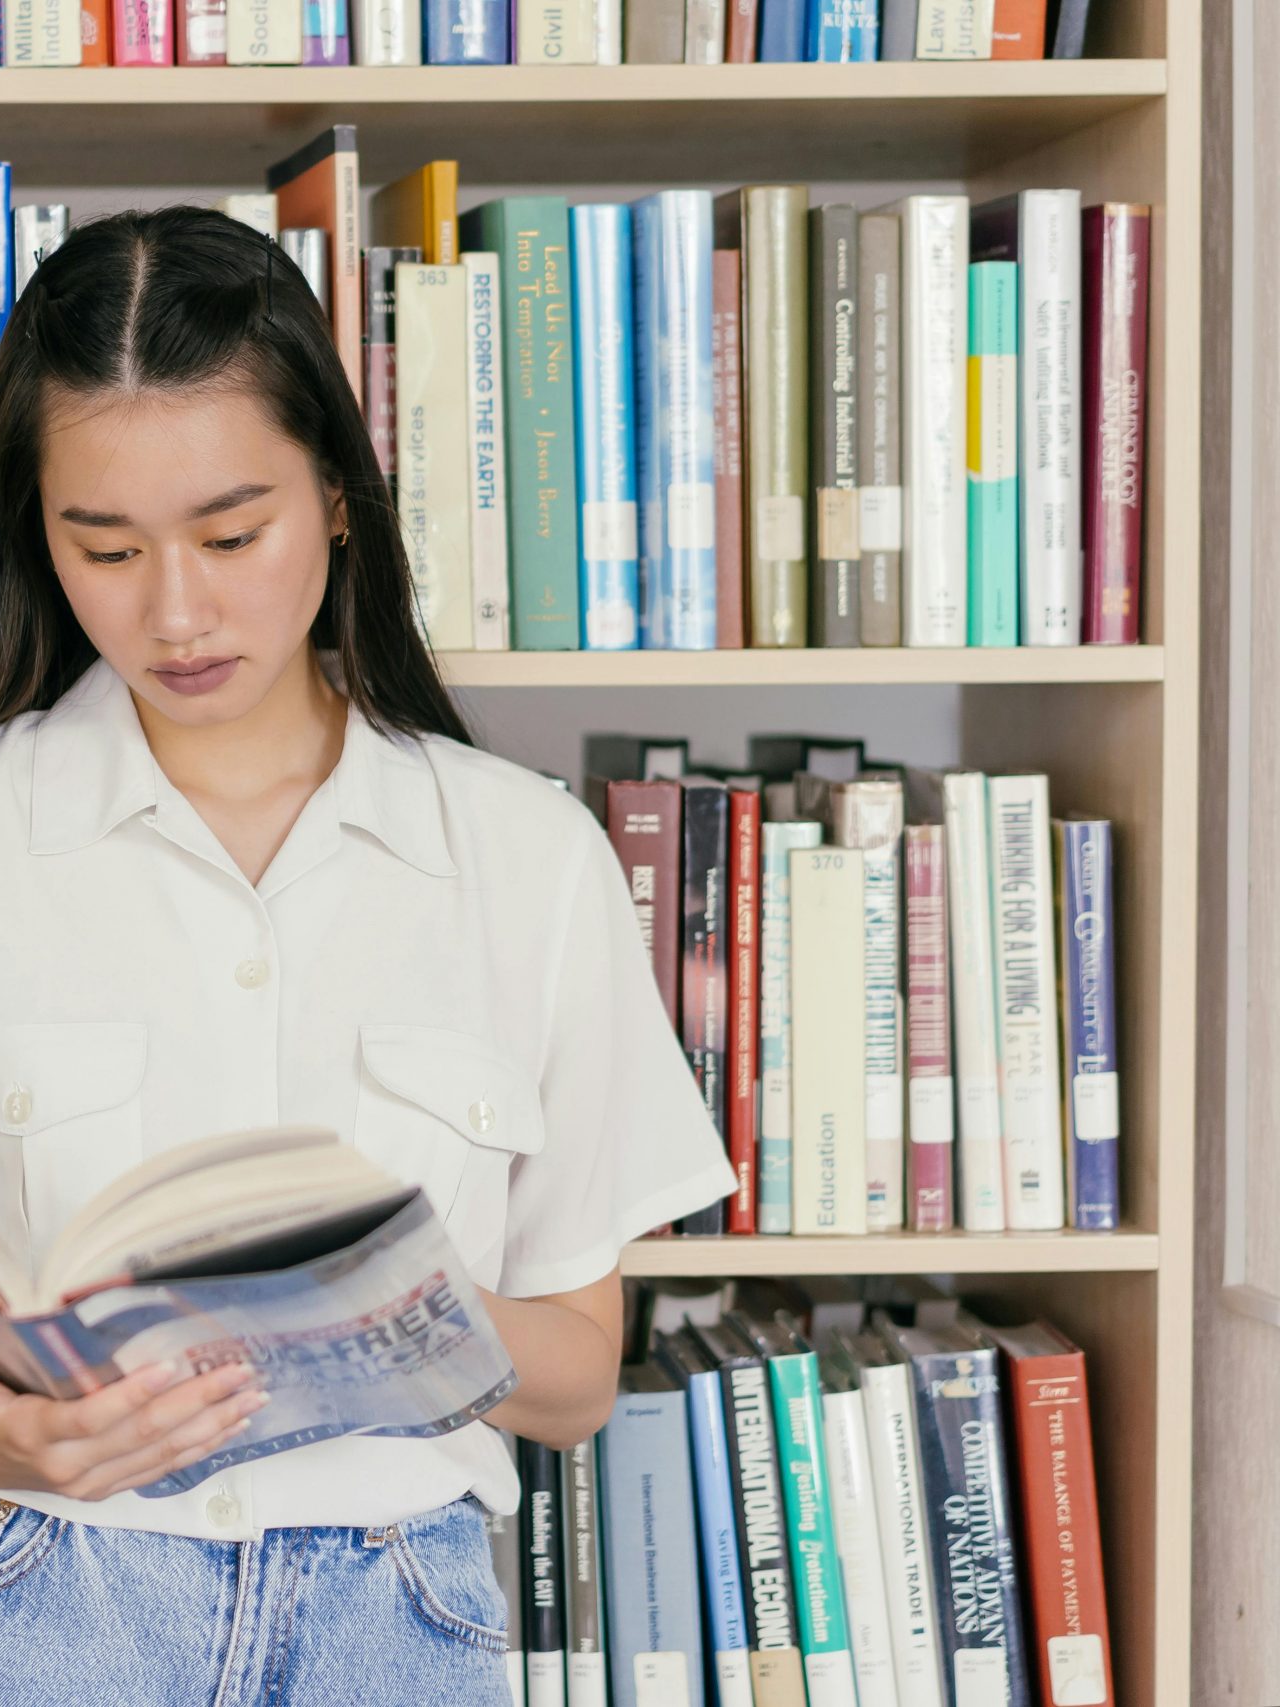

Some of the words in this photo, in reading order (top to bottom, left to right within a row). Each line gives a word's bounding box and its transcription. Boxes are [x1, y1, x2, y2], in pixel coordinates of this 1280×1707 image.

[543, 9, 562, 58] Civil
[926, 8, 943, 53] Law
[417, 269, 447, 285] 363
[517, 230, 540, 273] Into
[544, 245, 565, 294] Lead
[474, 273, 493, 393] RESTORING
[514, 278, 542, 399] Temptation
[546, 303, 566, 333] Us
[547, 340, 569, 383] Not
[833, 298, 854, 393] Controlling
[476, 398, 494, 434] THE
[835, 396, 854, 473] Industrial
[1119, 370, 1138, 508] CRIMINOLOGY
[410, 405, 426, 500] services
[477, 441, 495, 510] EARTH
[534, 428, 558, 481] Jason
[535, 488, 559, 538] Berry
[412, 507, 429, 574] social
[812, 856, 843, 870] 370
[999, 799, 1036, 893] THINKING
[1002, 899, 1037, 934] FOR
[1004, 939, 1037, 952] A
[1005, 958, 1040, 1017] LIVING
[816, 1113, 836, 1226] Education
[1048, 1409, 1066, 1445] THE
[730, 1367, 784, 1566] INTERNATIONAL
[960, 1420, 999, 1559] COMPETITIVE
[1051, 1449, 1071, 1526] BALANCE
[530, 1491, 553, 1554] Globalizing
[575, 1489, 593, 1528] Market
[640, 1474, 656, 1546] International
[891, 1413, 915, 1558] INTERNATIONAL
[907, 1564, 924, 1619] TRADE
[943, 1494, 971, 1526] OF
[534, 1556, 553, 1576] the
[577, 1530, 594, 1582] Structure
[716, 1527, 734, 1577] Saving
[1058, 1529, 1075, 1552] OF
[644, 1549, 658, 1602] Business
[721, 1580, 739, 1612] Free
[947, 1532, 979, 1634] NATIONS
